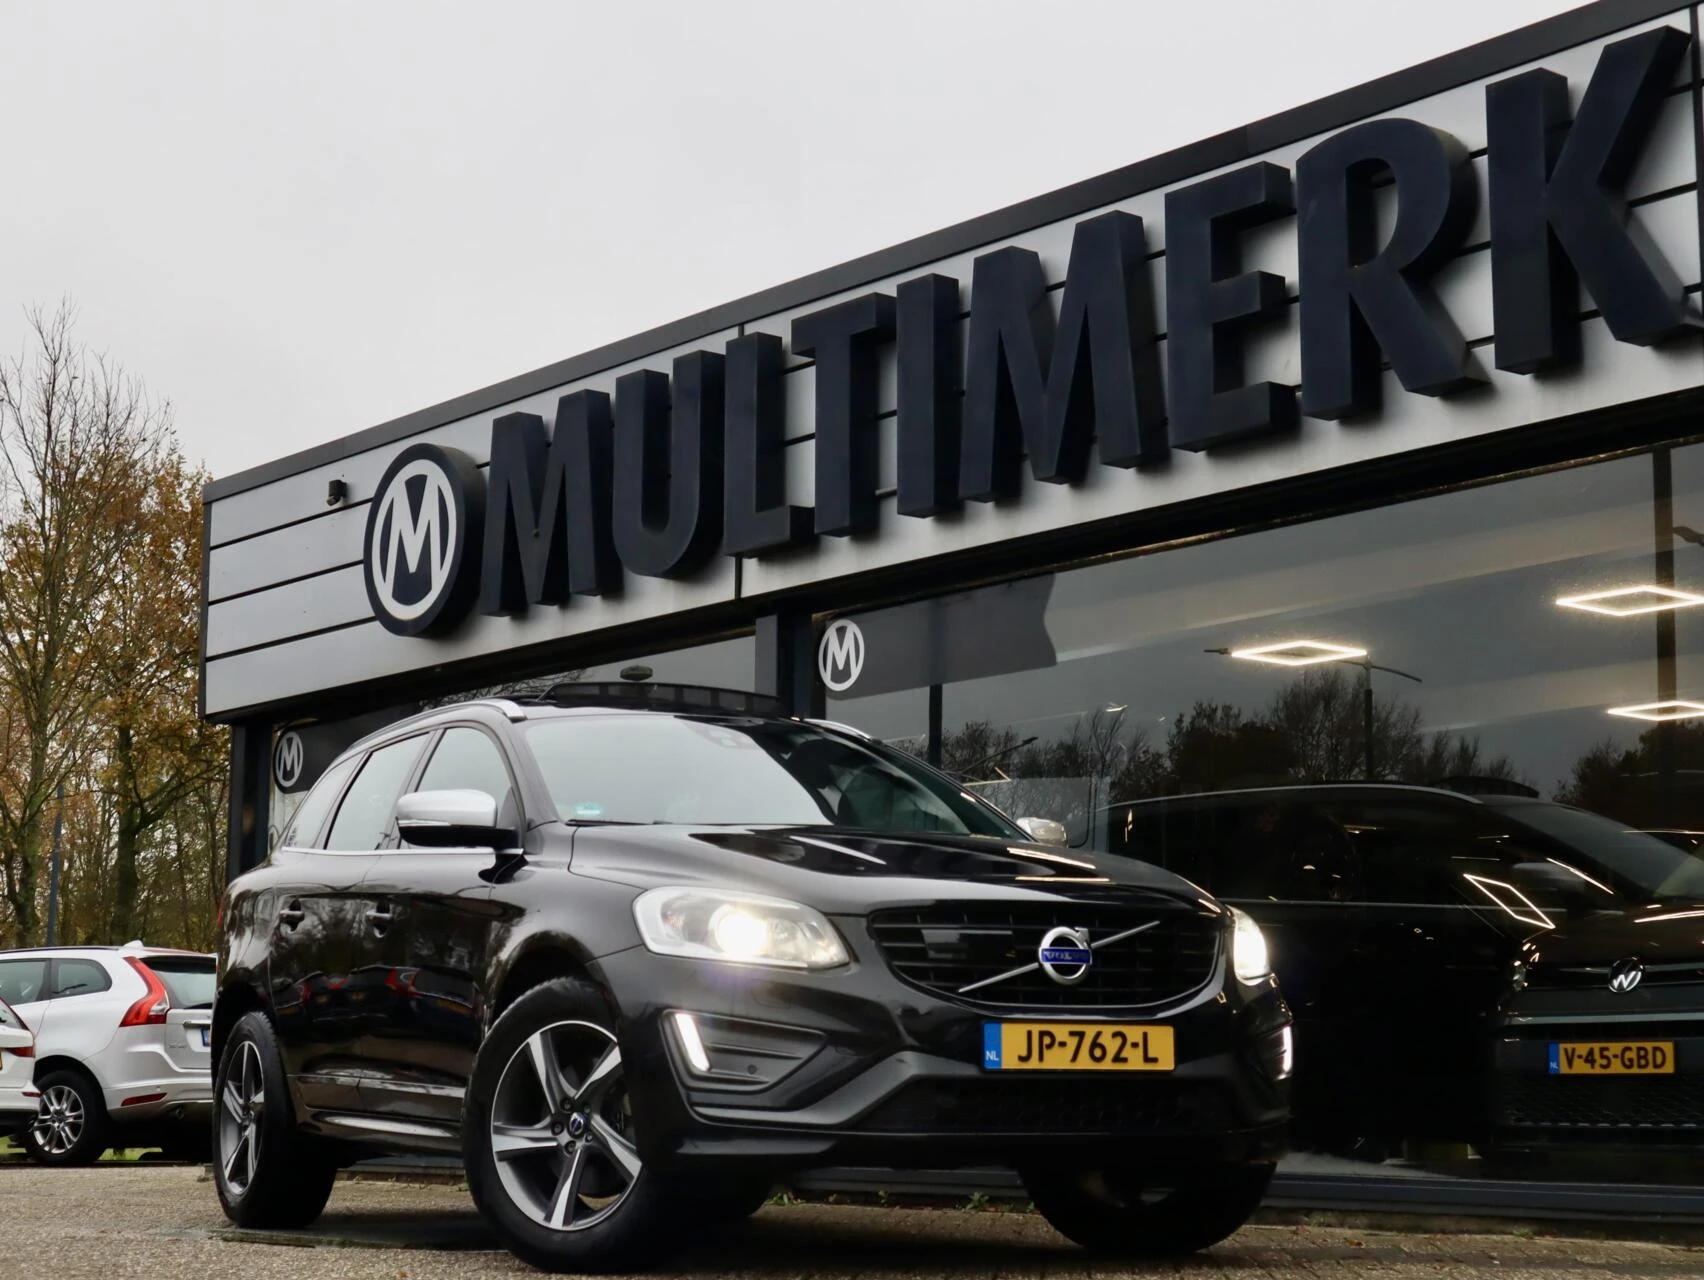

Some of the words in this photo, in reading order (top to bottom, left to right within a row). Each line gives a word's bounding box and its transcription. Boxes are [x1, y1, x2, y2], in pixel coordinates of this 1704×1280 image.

[377, 465, 450, 612] M
[480, 25, 1692, 618] MULTIMERK
[822, 620, 861, 688] M
[278, 733, 302, 785] M
[1044, 951, 1088, 961] VOL
[985, 1051, 999, 1061] NL
[1017, 1030, 1159, 1063] JP-762-L
[1563, 1046, 1667, 1070] V-45-GBD
